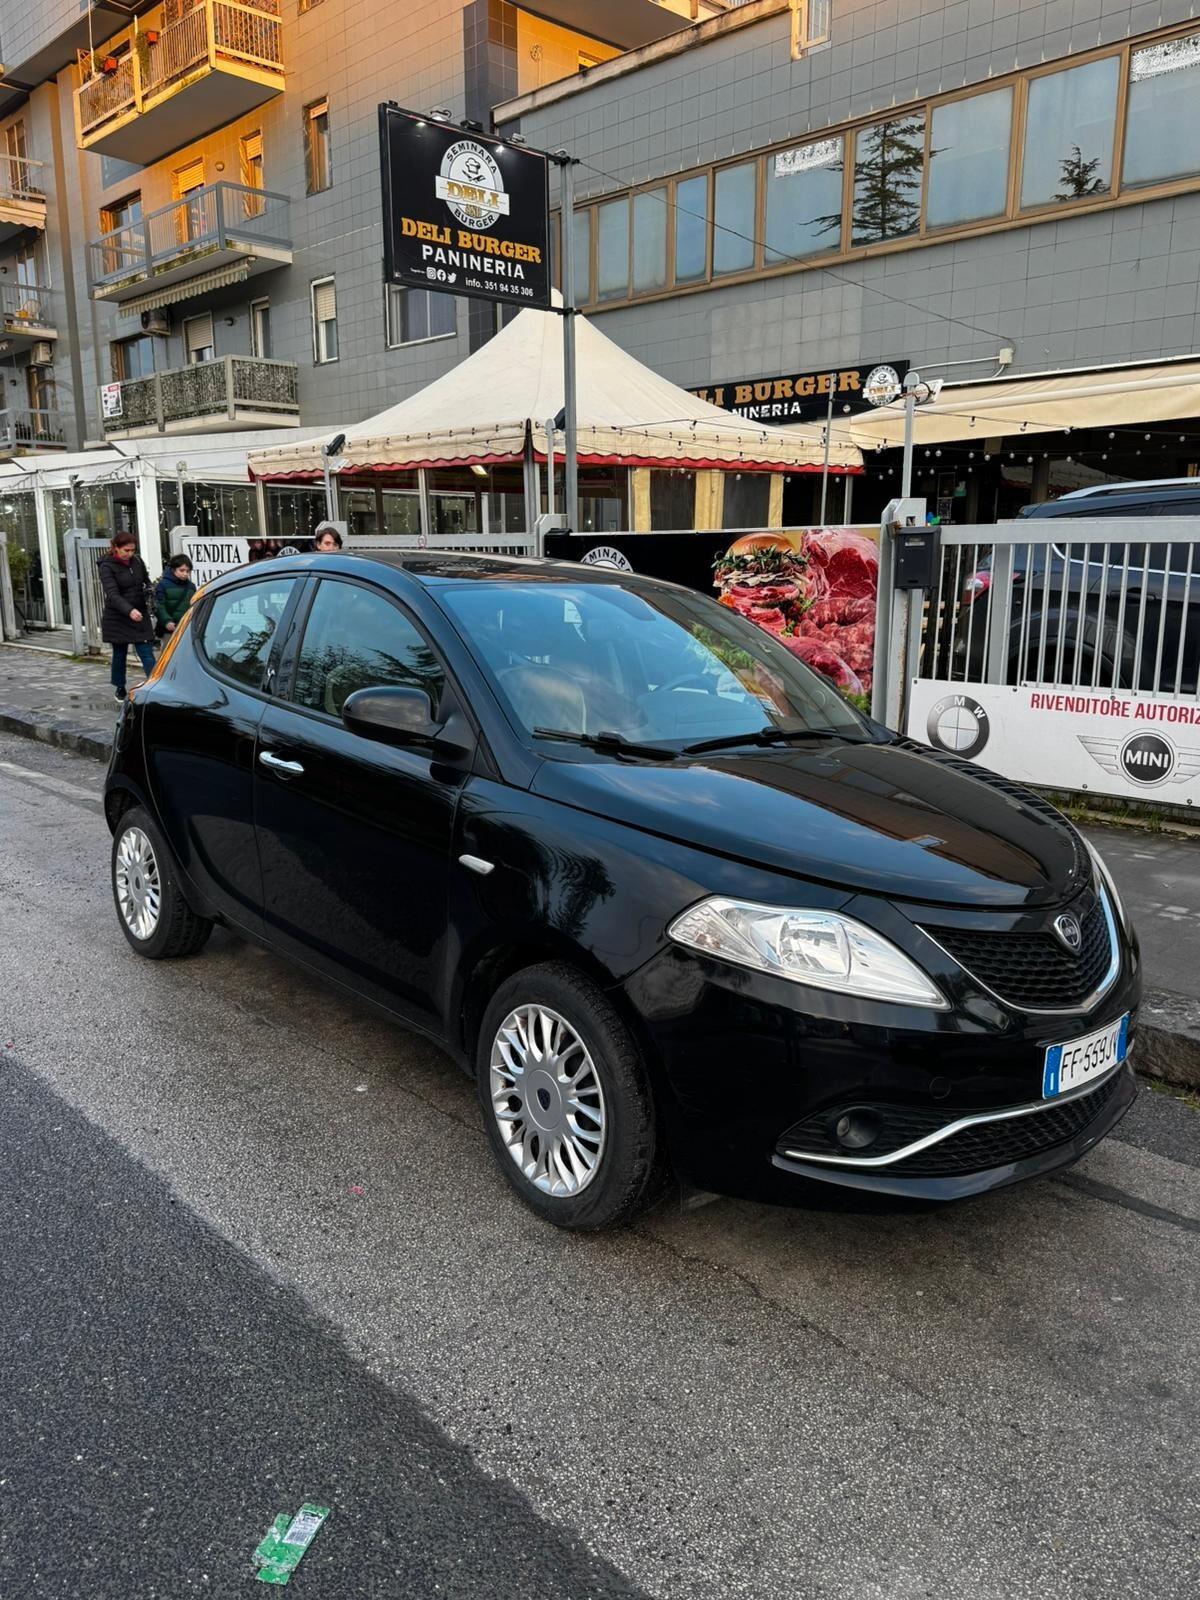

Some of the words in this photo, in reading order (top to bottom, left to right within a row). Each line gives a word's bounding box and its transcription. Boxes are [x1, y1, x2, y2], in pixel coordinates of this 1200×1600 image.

[446, 142, 497, 174] SEMINARA
[447, 180, 500, 209] DELI
[454, 208, 495, 228] BURGER
[401, 217, 452, 245] DELI
[458, 230, 542, 264] BURGER
[422, 244, 525, 280] PANINERIA
[465, 277, 483, 289] info.
[485, 280, 498, 291] 351
[500, 283, 509, 293] 94
[510, 285, 519, 295] 35
[520, 287, 534, 297] 306
[690, 387, 725, 406] LI
[735, 370, 861, 404] BURGER
[187, 543, 242, 564] VENDITA
[583, 548, 630, 571] MINAR
[935, 696, 986, 719] BMW
[1030, 693, 1130, 718] RIVENDITORE
[1125, 749, 1169, 769] MINI
